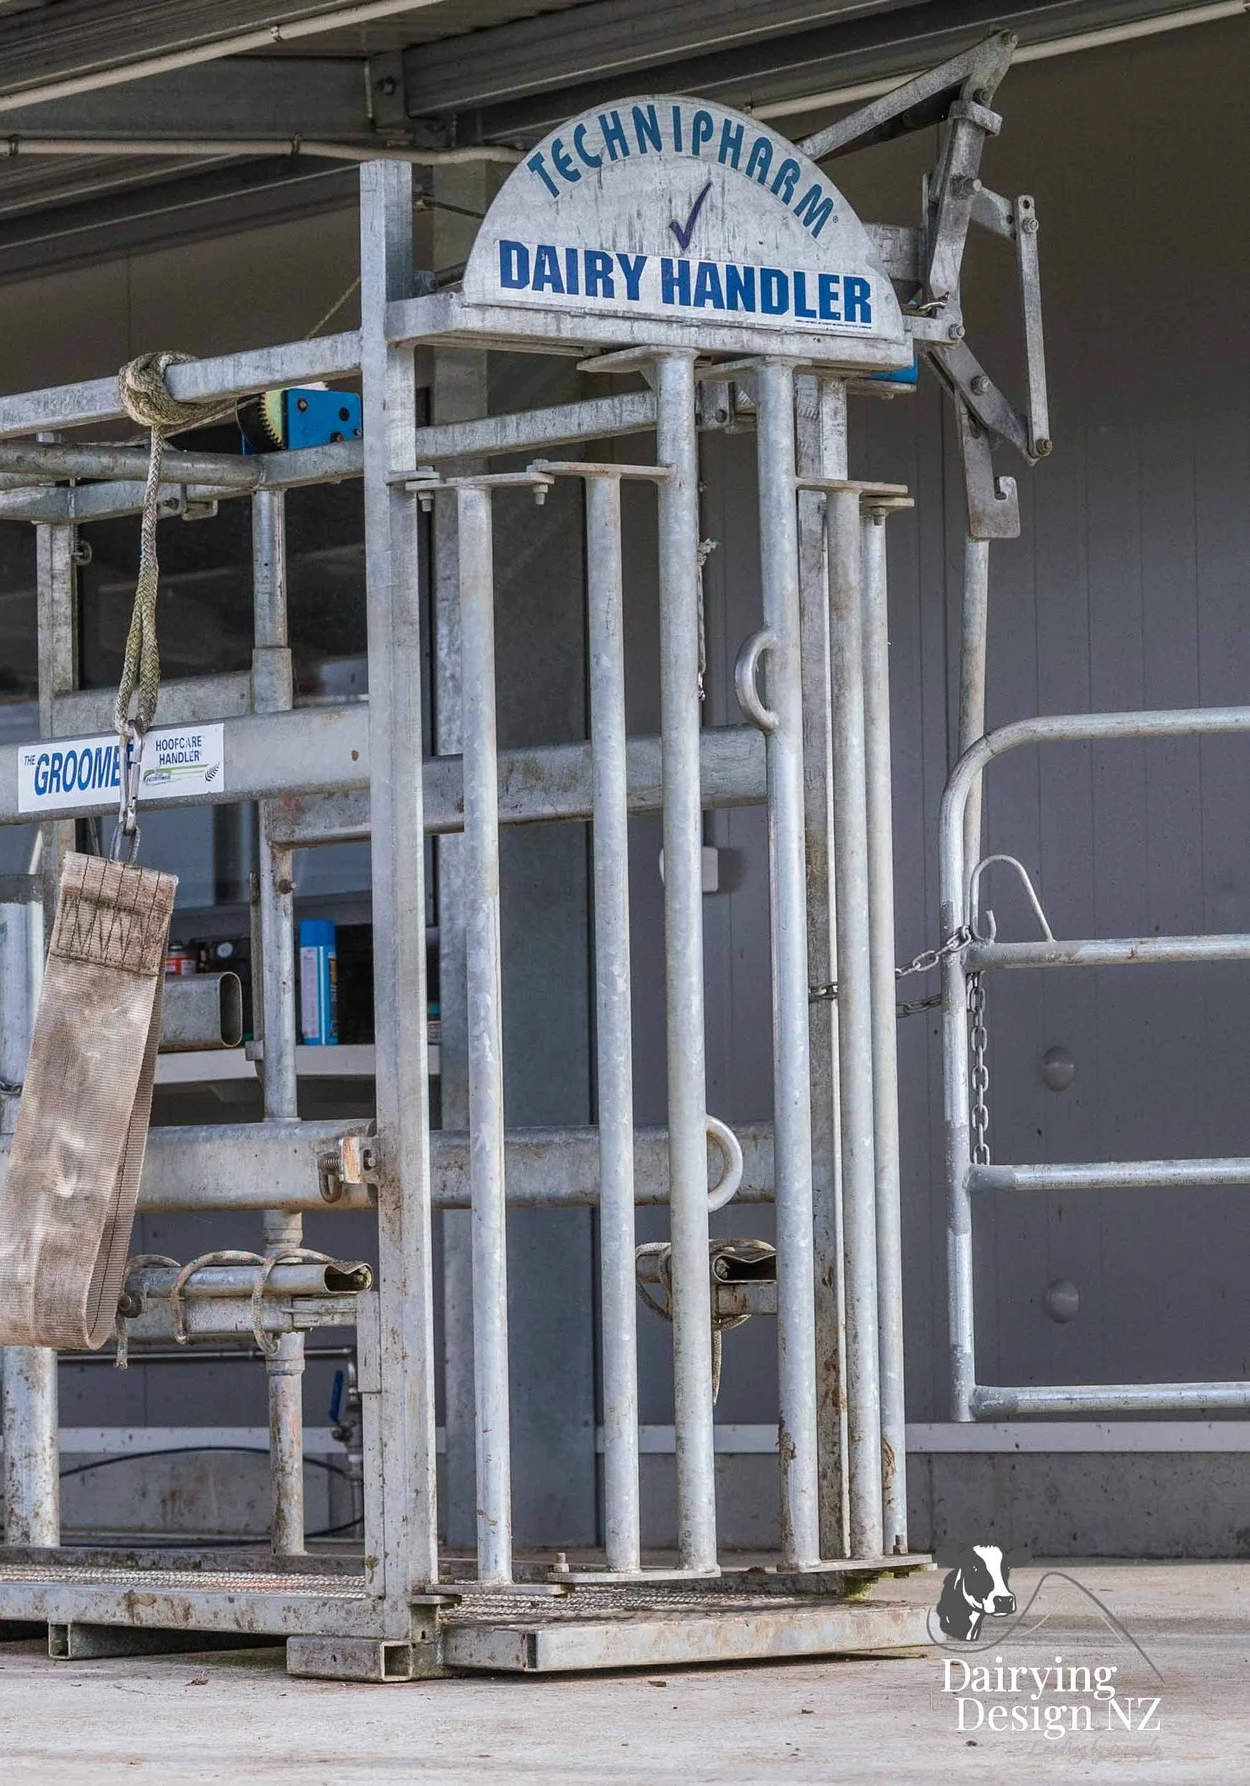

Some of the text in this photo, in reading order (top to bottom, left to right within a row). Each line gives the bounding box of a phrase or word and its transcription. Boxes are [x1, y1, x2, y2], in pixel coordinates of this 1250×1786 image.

[499, 240, 872, 324] DAIRY HANDLER
[155, 735, 202, 751] HOOFCARE
[24, 755, 36, 766] THE
[159, 750, 200, 765] HANDLER
